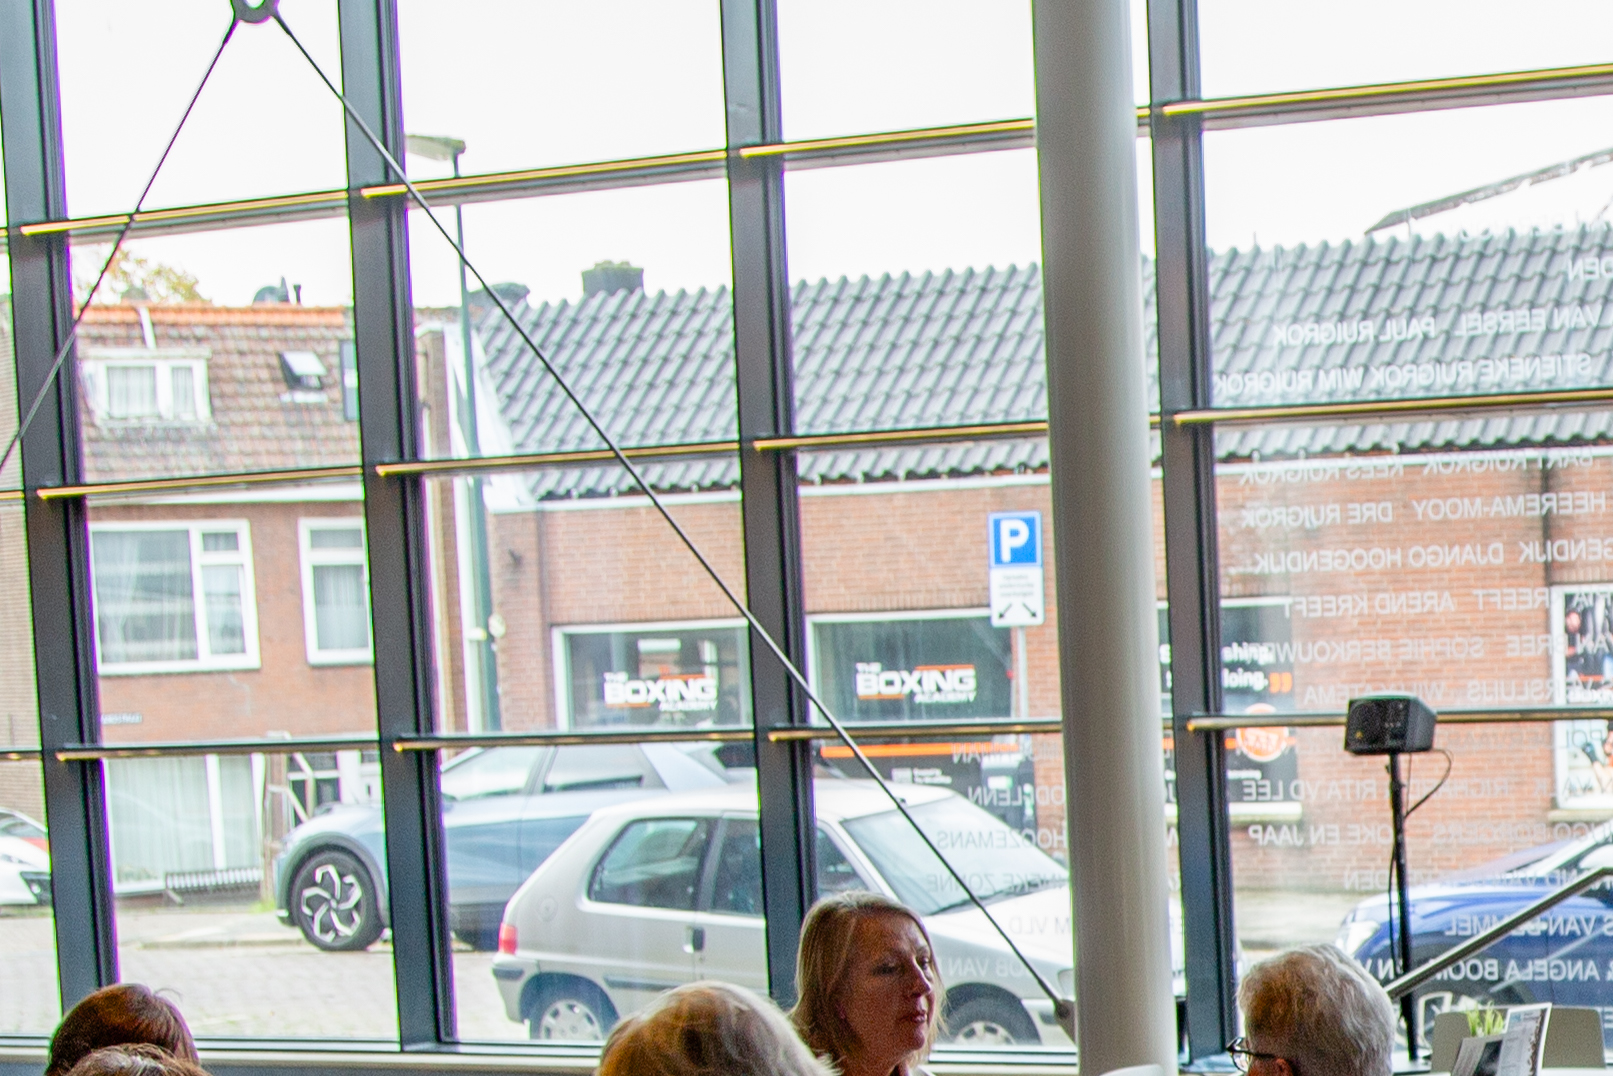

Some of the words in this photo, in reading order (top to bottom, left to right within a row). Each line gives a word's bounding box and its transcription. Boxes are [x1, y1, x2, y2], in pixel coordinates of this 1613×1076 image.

[1000, 519, 1030, 563] P
[604, 678, 719, 704] BOXING
[856, 669, 976, 696] BOXING
